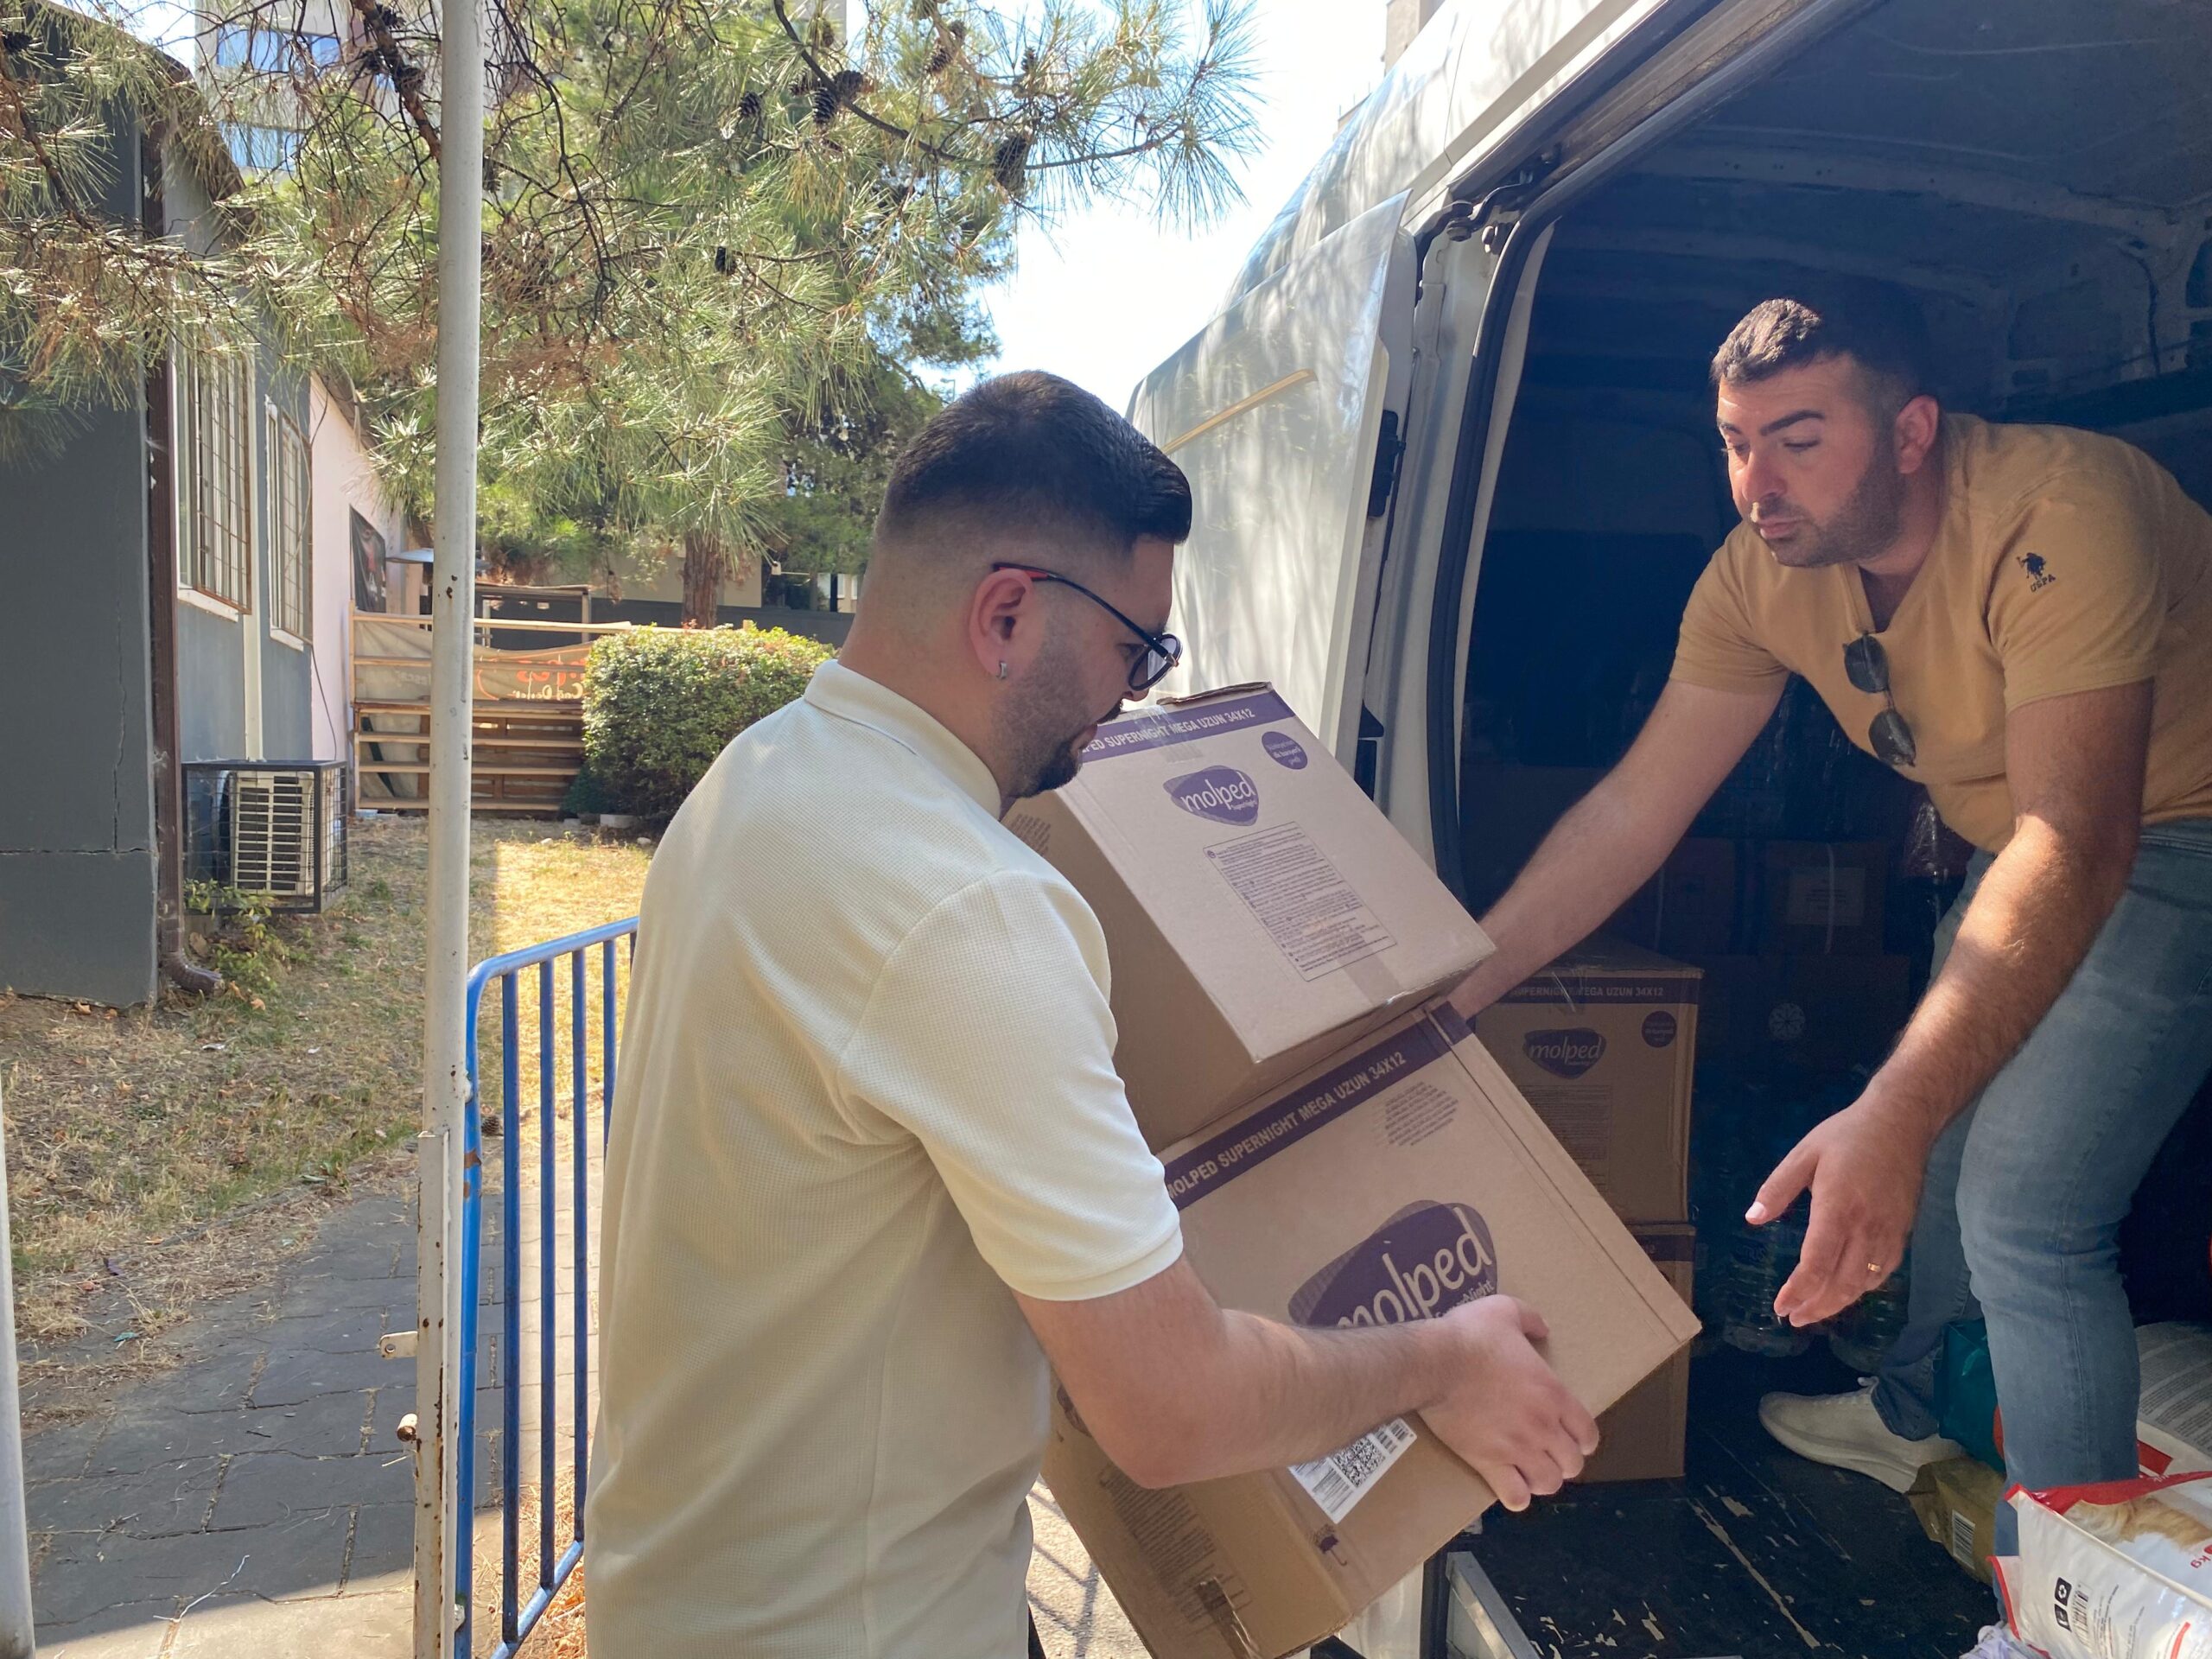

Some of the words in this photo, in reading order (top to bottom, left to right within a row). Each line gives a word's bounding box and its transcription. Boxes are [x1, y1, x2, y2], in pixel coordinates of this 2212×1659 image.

[2031, 574, 2056, 593] USPA
[1104, 725, 1171, 748] SUPERNIGHT
[1168, 720, 1201, 734] MEGA
[1198, 714, 1228, 729] UZUN
[1224, 708, 1256, 724] 34X12
[1180, 771, 1256, 812] molped
[1606, 987, 1633, 996] UZUN
[1635, 987, 1664, 996] 34X12
[1529, 1036, 1602, 1065] molped
[1166, 1160, 1219, 1198] MOLPED
[1217, 1111, 1300, 1168] SUPERNIGHT
[1298, 1092, 1338, 1122] MEGA
[1333, 1071, 1371, 1100] UZUN
[1368, 1051, 1408, 1080] 34X12
